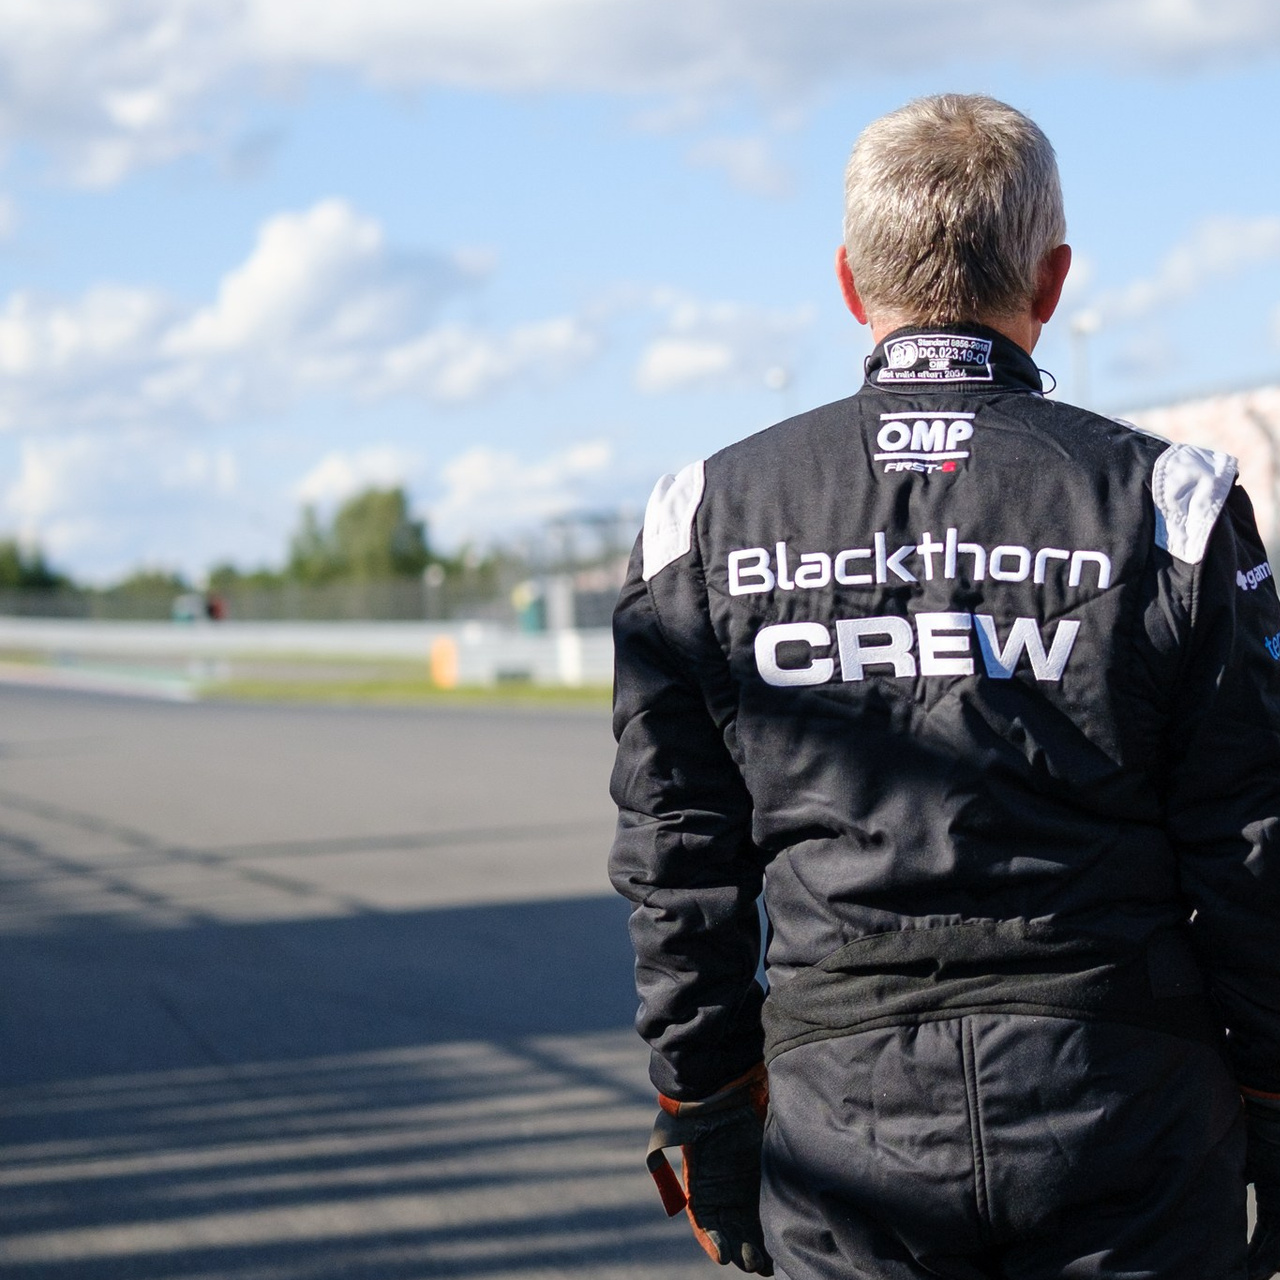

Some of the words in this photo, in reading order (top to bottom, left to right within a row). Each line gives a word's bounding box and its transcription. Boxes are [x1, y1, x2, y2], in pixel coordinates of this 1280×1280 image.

[917, 338, 950, 347] Standard
[918, 346, 985, 365] DC.023.19-O
[895, 370, 916, 379] valid
[877, 420, 974, 452] OMP
[884, 461, 957, 474] FIRST-S
[728, 528, 1112, 596] Blackthorn
[754, 612, 1081, 687] CREW
